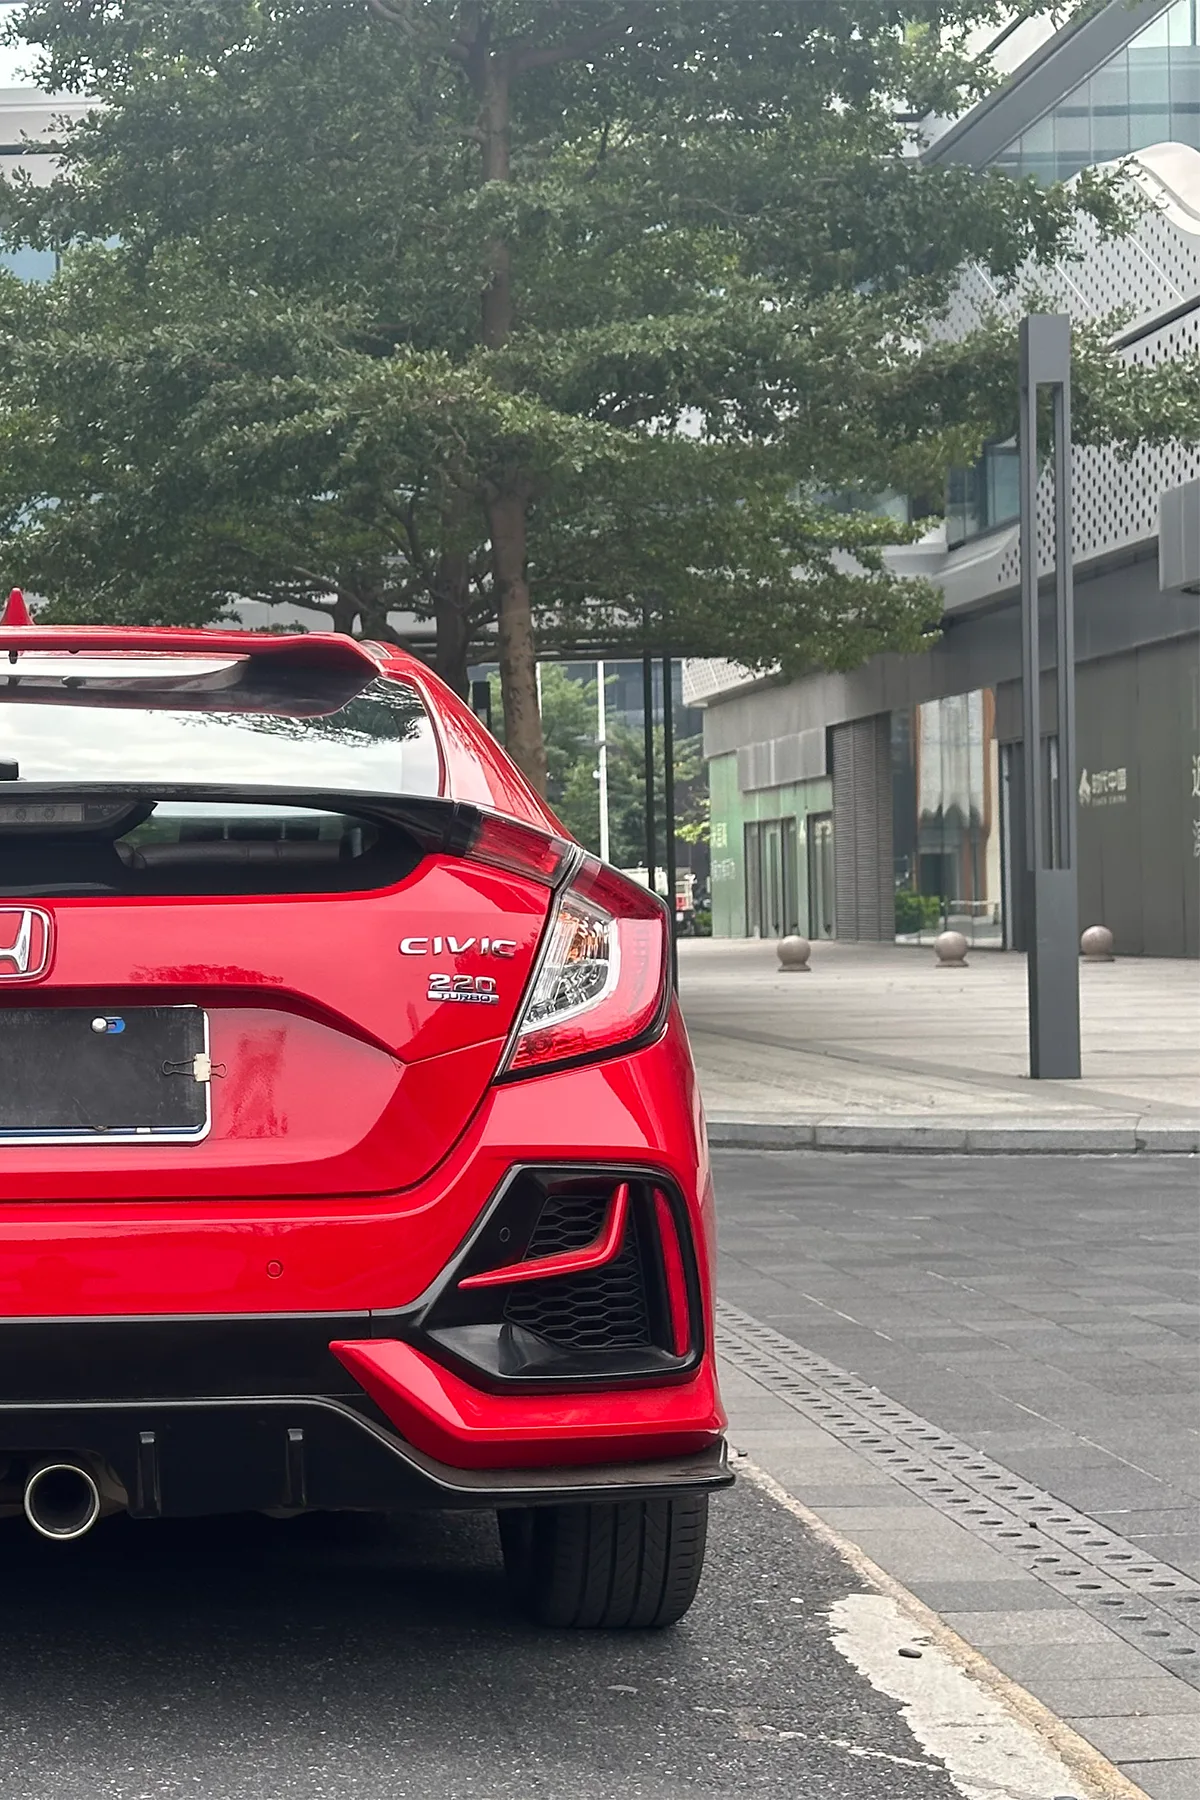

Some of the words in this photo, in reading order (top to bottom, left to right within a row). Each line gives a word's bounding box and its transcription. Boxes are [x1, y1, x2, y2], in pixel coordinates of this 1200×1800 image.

[399, 936, 517, 958] CIVIC
[427, 973, 497, 993] 220
[438, 992, 492, 1003] TURBO
